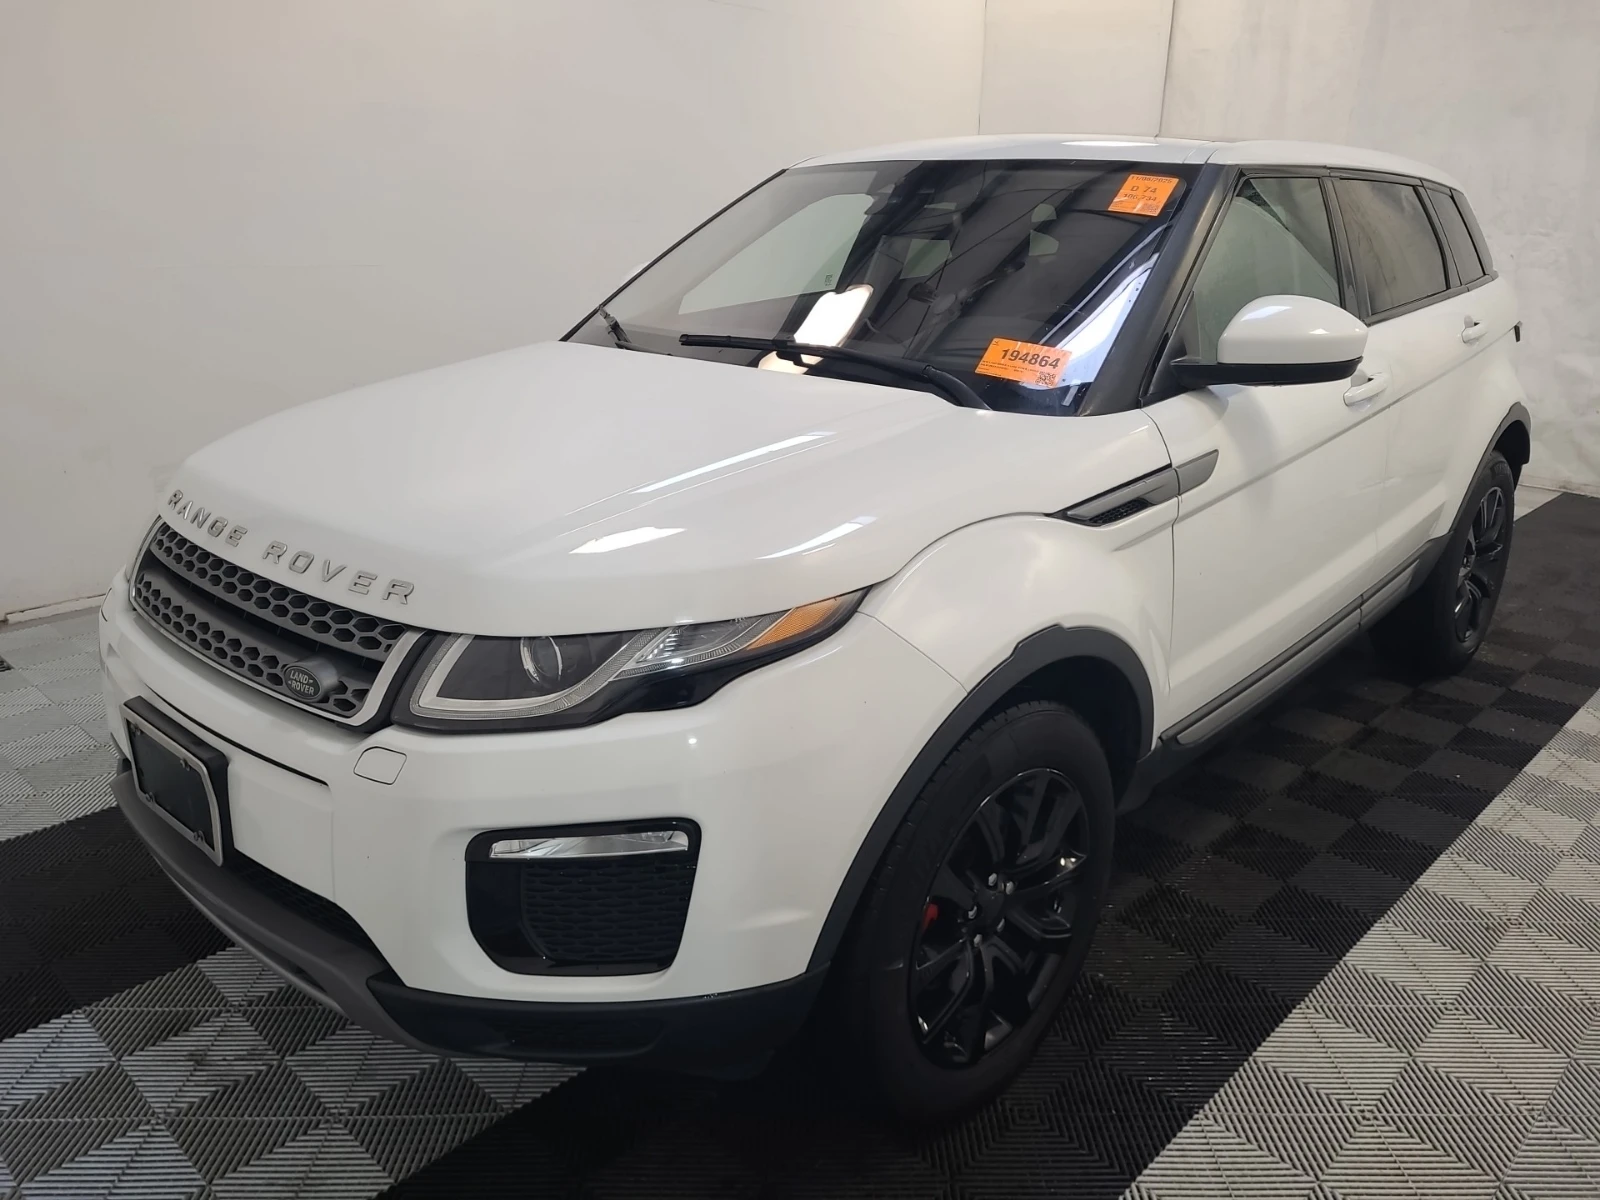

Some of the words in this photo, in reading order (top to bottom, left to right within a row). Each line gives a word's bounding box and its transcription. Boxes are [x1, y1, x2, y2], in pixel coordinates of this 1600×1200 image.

[1001, 348, 1061, 369] 194864
[167, 489, 248, 548] RANGE
[262, 540, 415, 605] ROVER
[289, 670, 309, 684] LAND
[291, 680, 315, 696] ROVER
